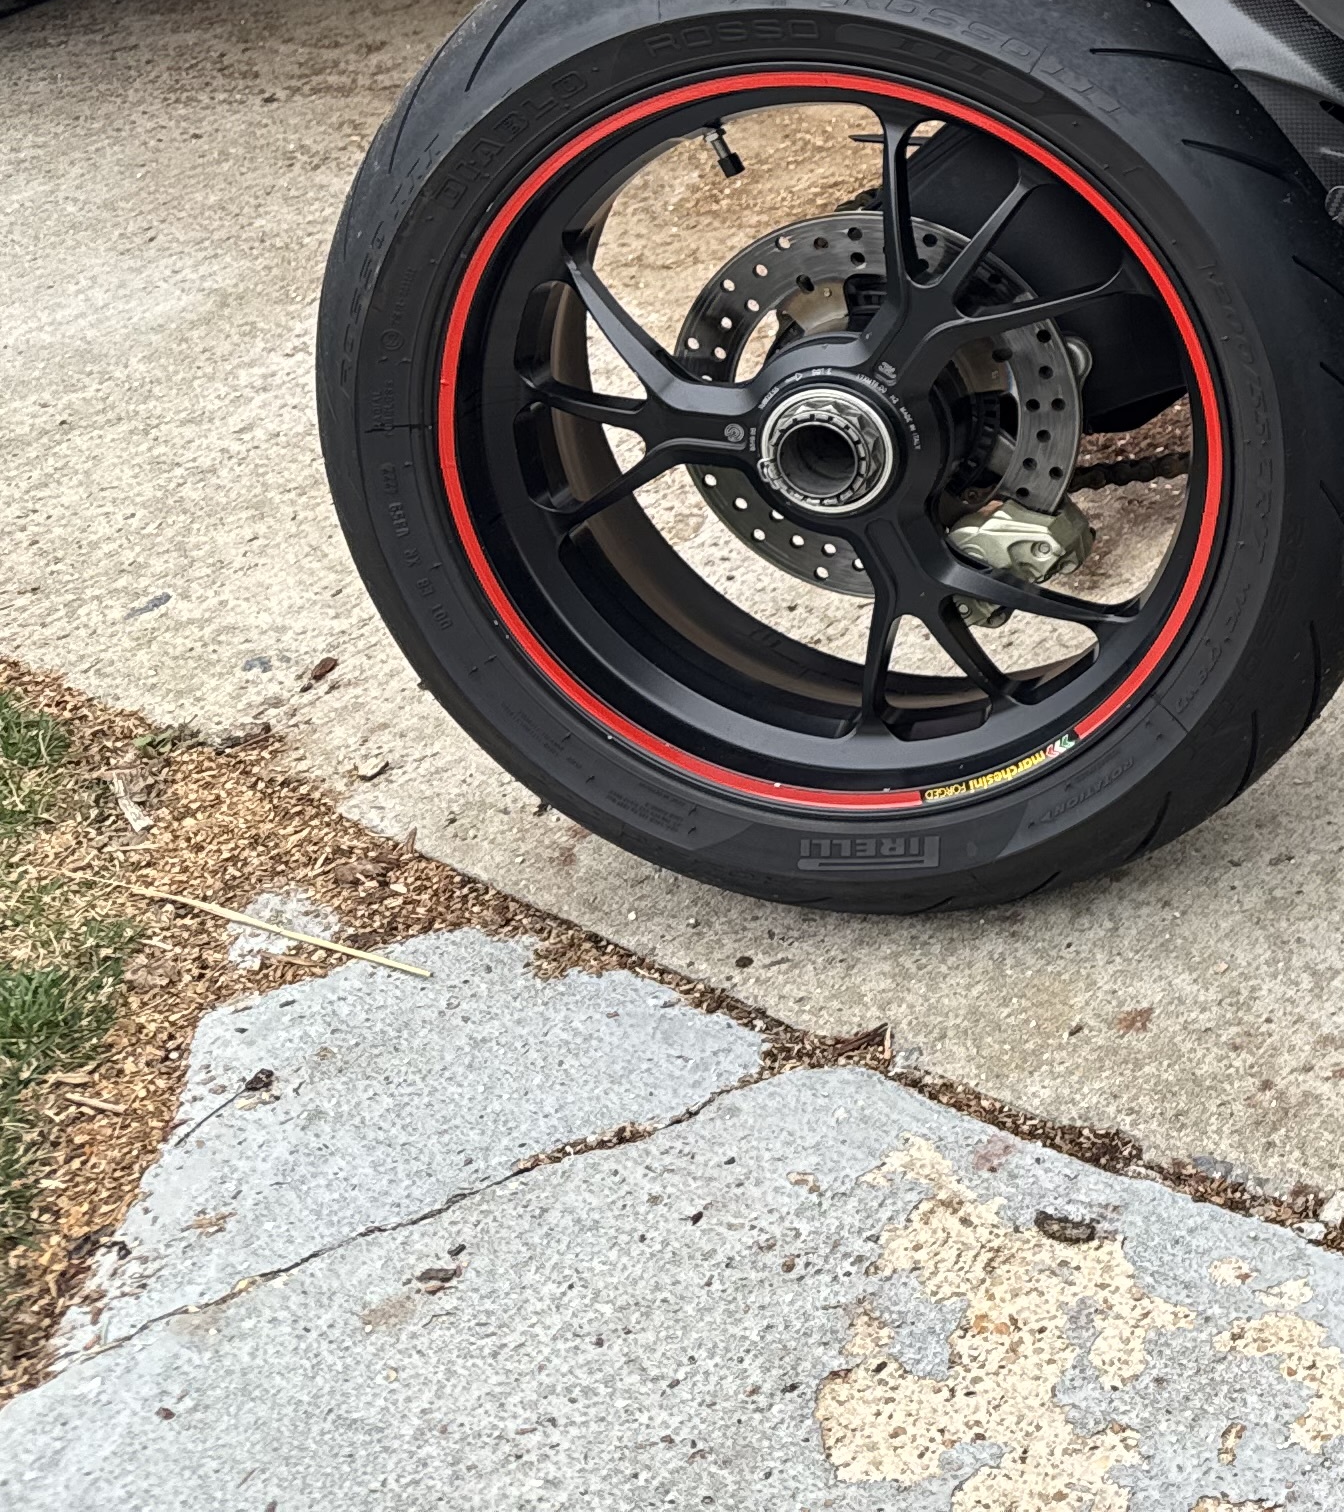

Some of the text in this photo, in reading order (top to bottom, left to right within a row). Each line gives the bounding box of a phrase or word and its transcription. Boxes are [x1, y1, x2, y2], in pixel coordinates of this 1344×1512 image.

[435, 69, 590, 207] DIABLO
[644, 17, 819, 57] ROSSO
[969, 749, 1046, 794] marchesini
[924, 782, 967, 803] FORGED
[796, 834, 940, 872] PIRELLI
